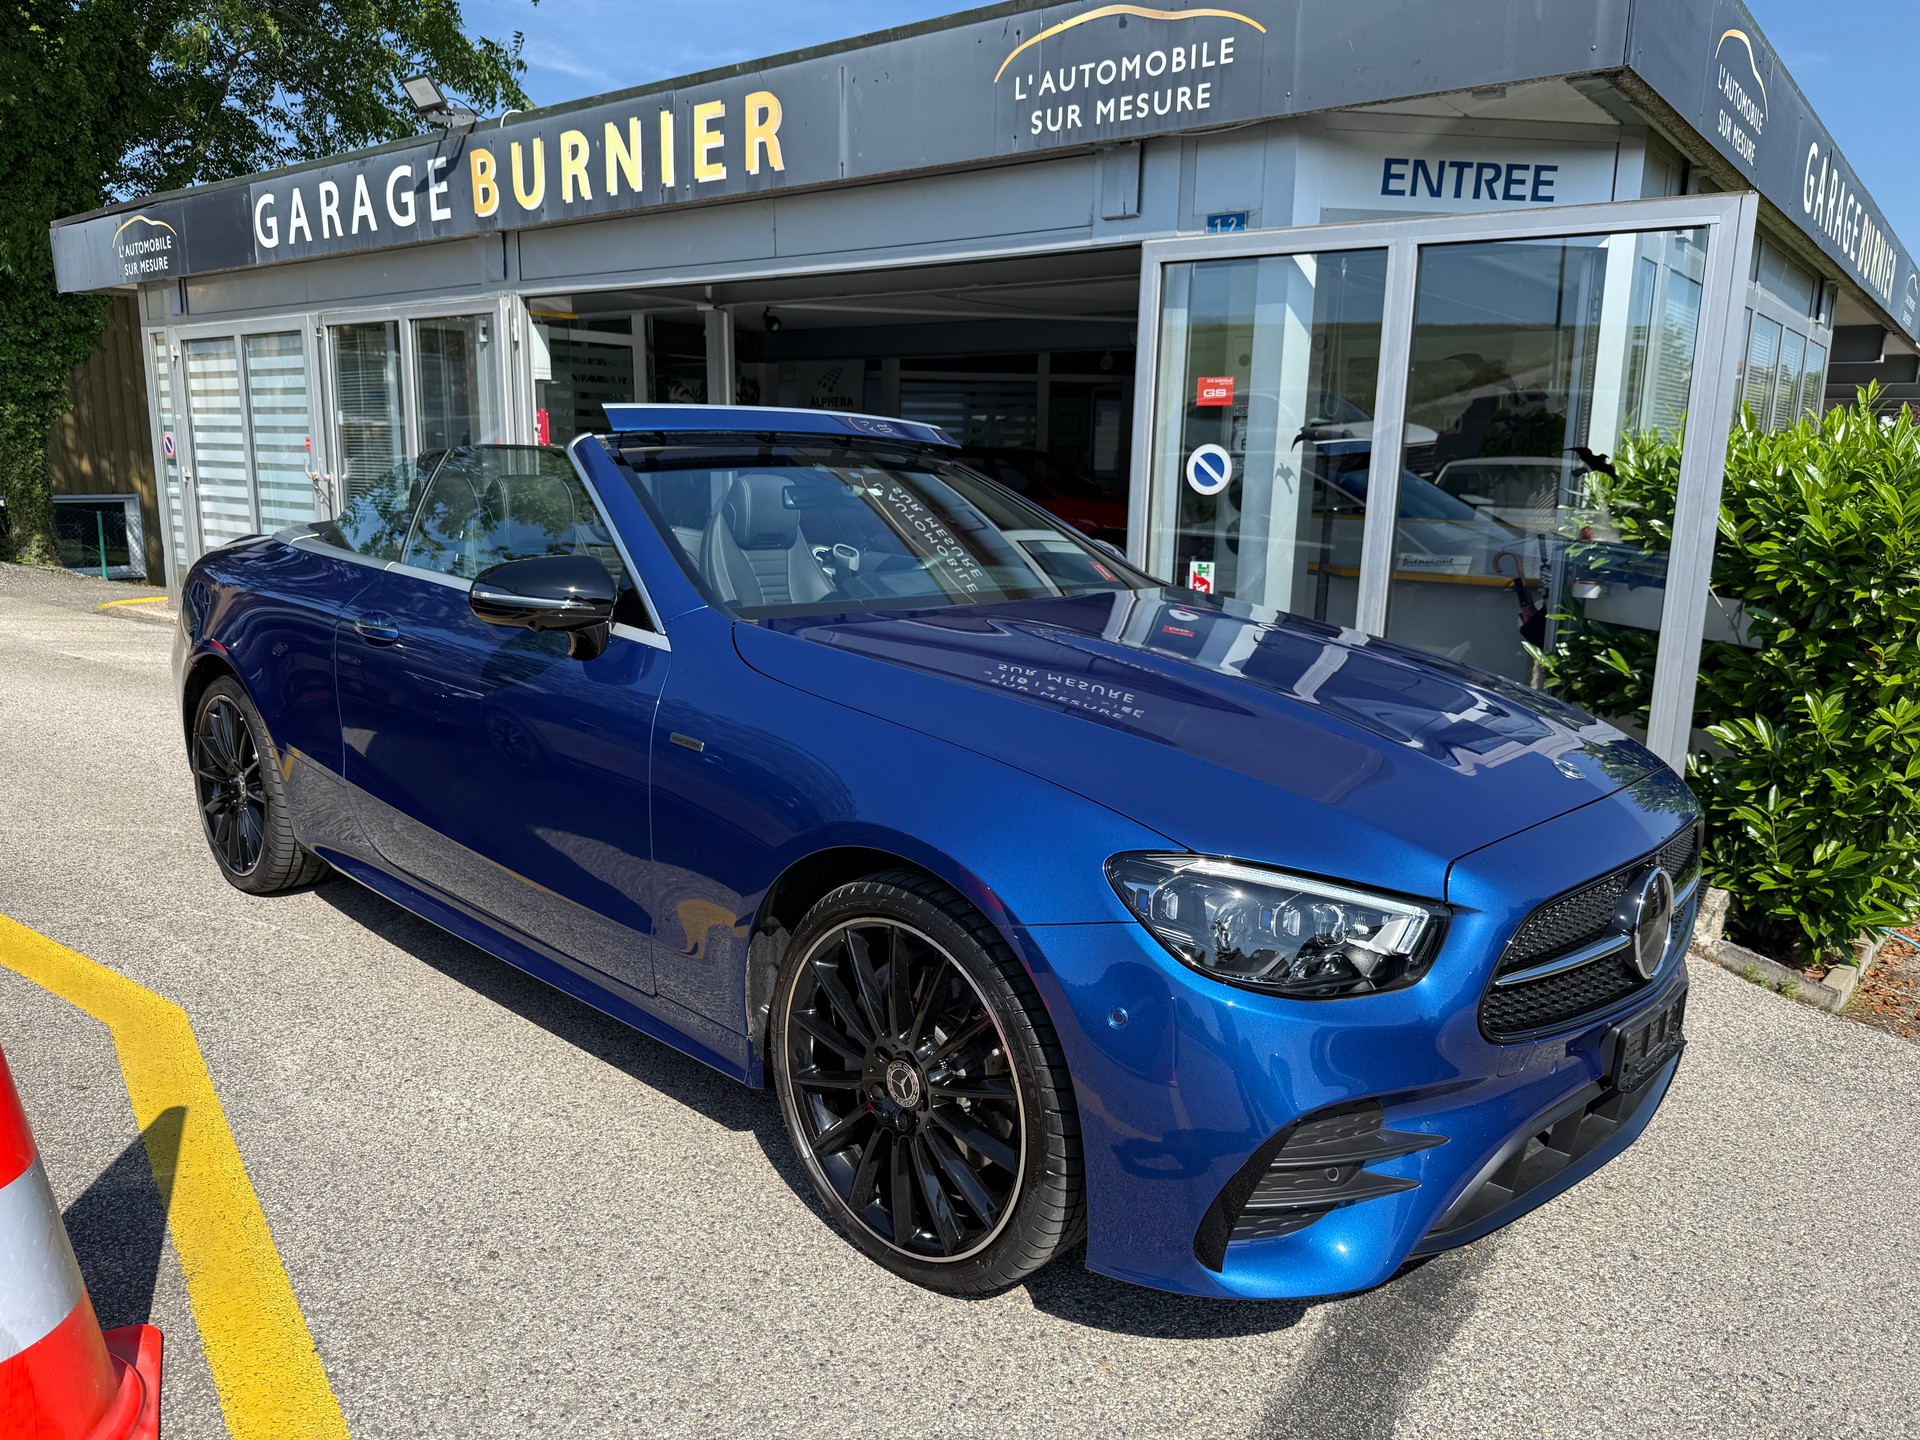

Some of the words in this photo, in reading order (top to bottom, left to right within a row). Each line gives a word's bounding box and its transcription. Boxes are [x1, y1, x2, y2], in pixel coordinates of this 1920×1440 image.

[1015, 37, 1235, 100] L'AUTOMOBILE
[1030, 104, 1083, 135] SUR
[1095, 82, 1212, 125] MESURE
[1718, 63, 1764, 135] L'AUTOMOBILE
[1718, 108, 1732, 142] SUR
[1732, 123, 1756, 167] MESURE
[254, 156, 453, 249] GARAGE
[470, 91, 786, 218] BURNIER
[1380, 157, 1559, 203] ENTREE
[118, 235, 172, 259] L'AUTOMOBILE
[1213, 217, 1238, 233] 12
[1803, 141, 1862, 262] GARAGE
[1857, 212, 1898, 304] BURNIER
[124, 262, 139, 276] SUR
[140, 256, 169, 273] MESURE
[810, 396, 854, 408] ALPHERA
[1203, 388, 1227, 398] GS
